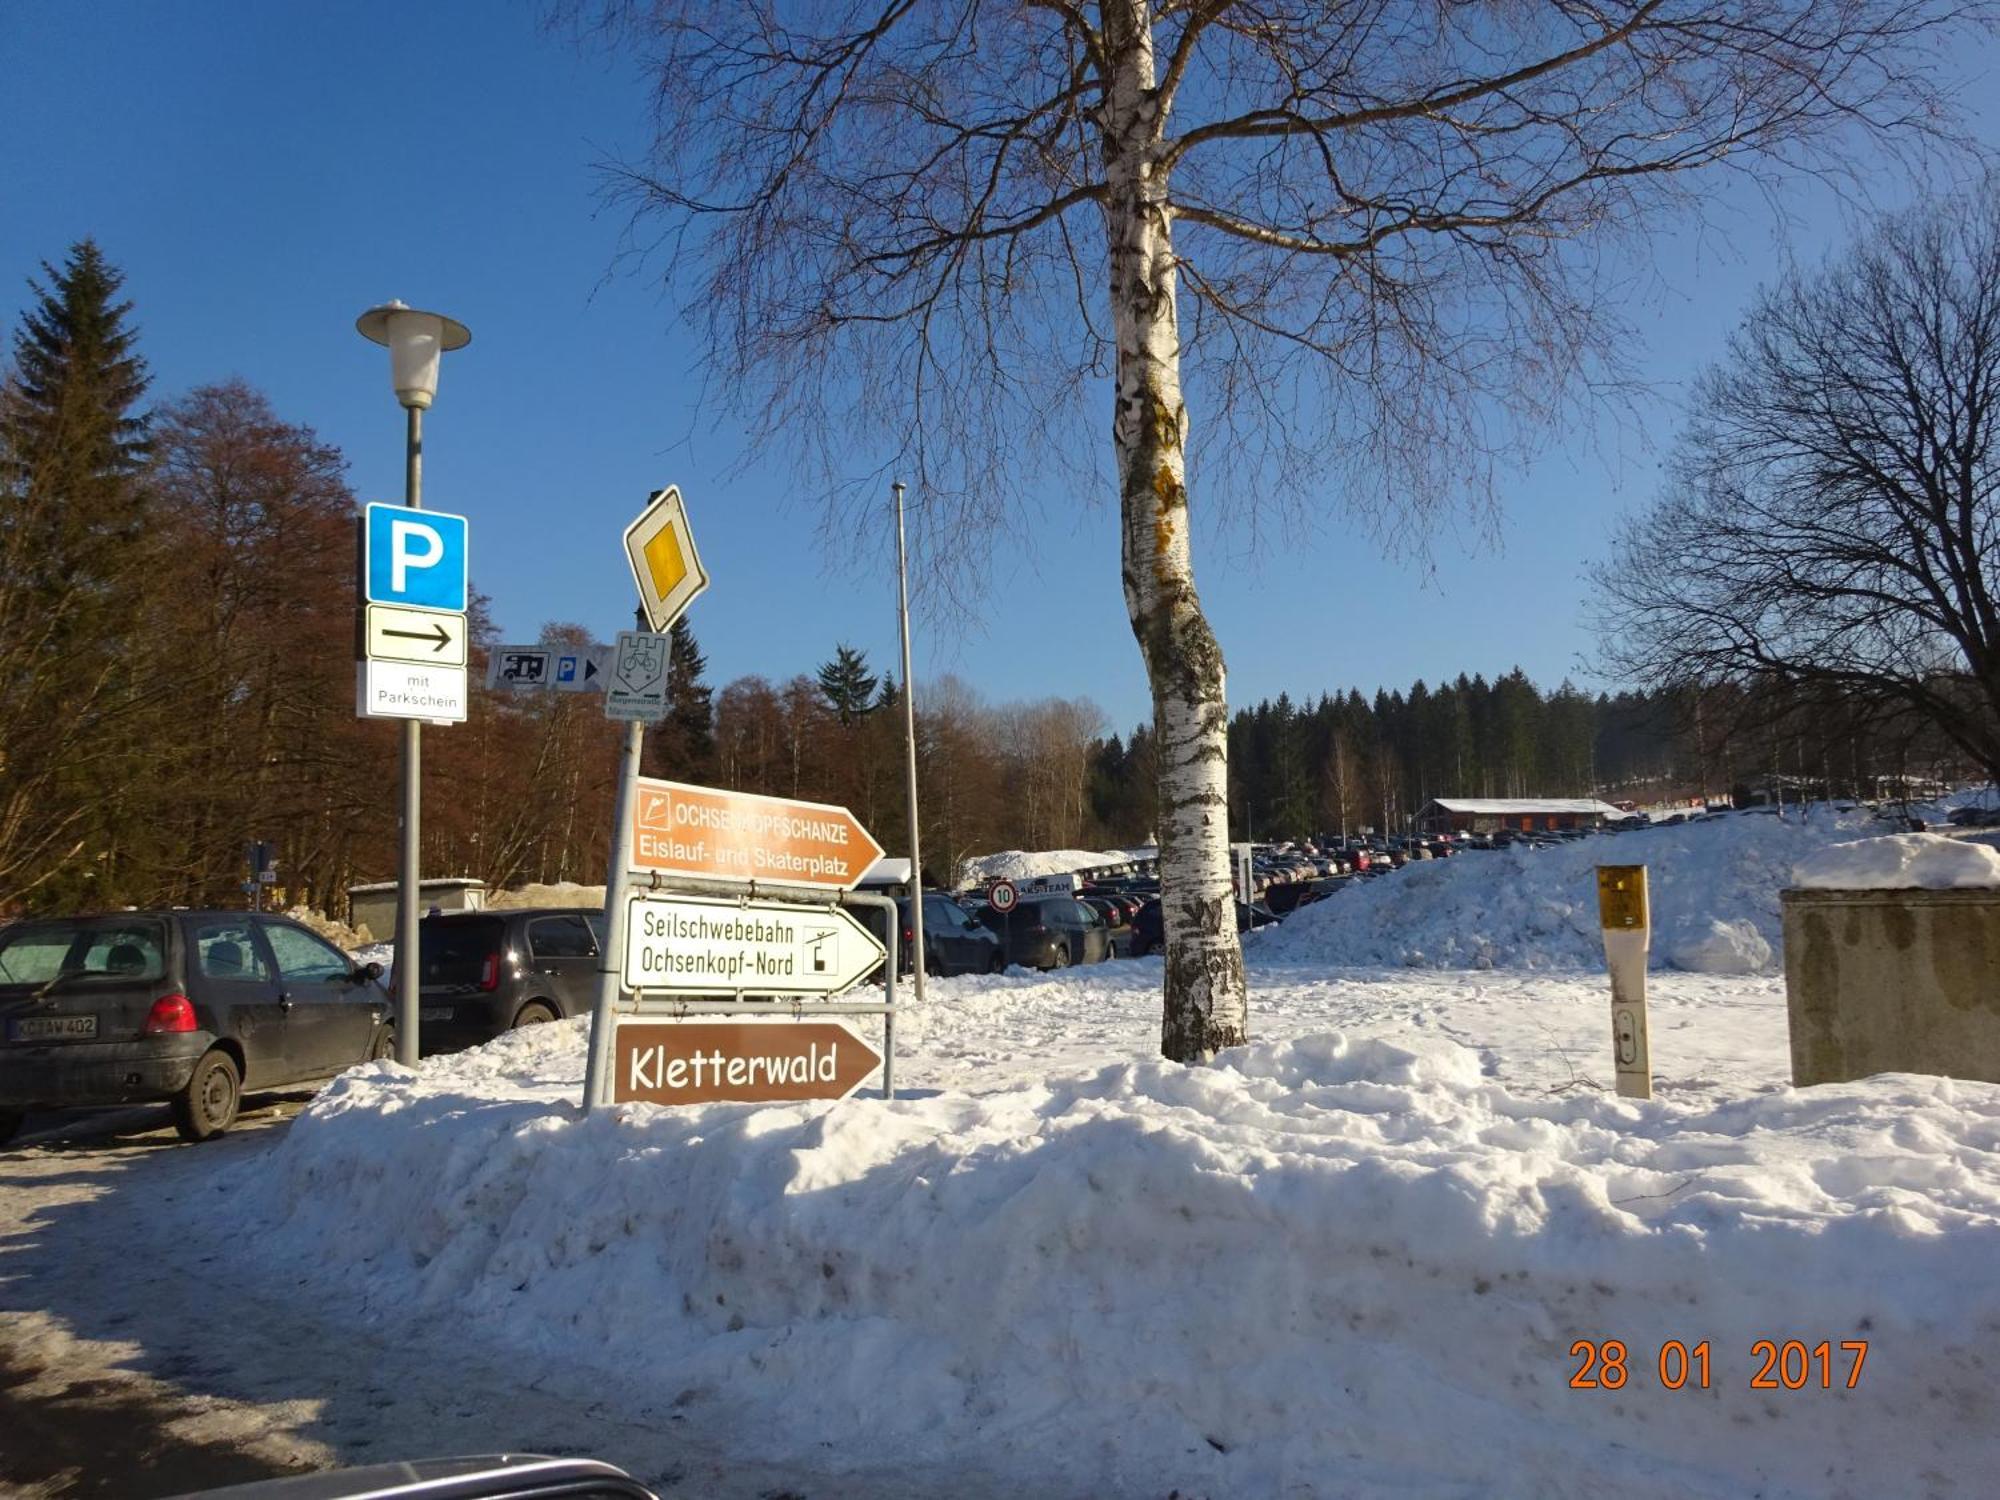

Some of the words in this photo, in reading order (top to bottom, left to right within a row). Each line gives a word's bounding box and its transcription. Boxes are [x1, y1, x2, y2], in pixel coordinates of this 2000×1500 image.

[392, 519, 445, 592] P
[407, 675, 430, 687] mit
[559, 659, 574, 680] P
[378, 690, 457, 708] Parkschein
[639, 835, 710, 862] Eislauf-
[715, 847, 749, 865] und
[754, 847, 849, 876] Skaterplatz
[997, 889, 1010, 903] 10
[643, 911, 794, 944] Seilschwebebahn
[642, 946, 793, 980] Ochsenkopf-Nord
[66, 1019, 94, 1033] 402
[630, 1043, 837, 1092] Kletterwald
